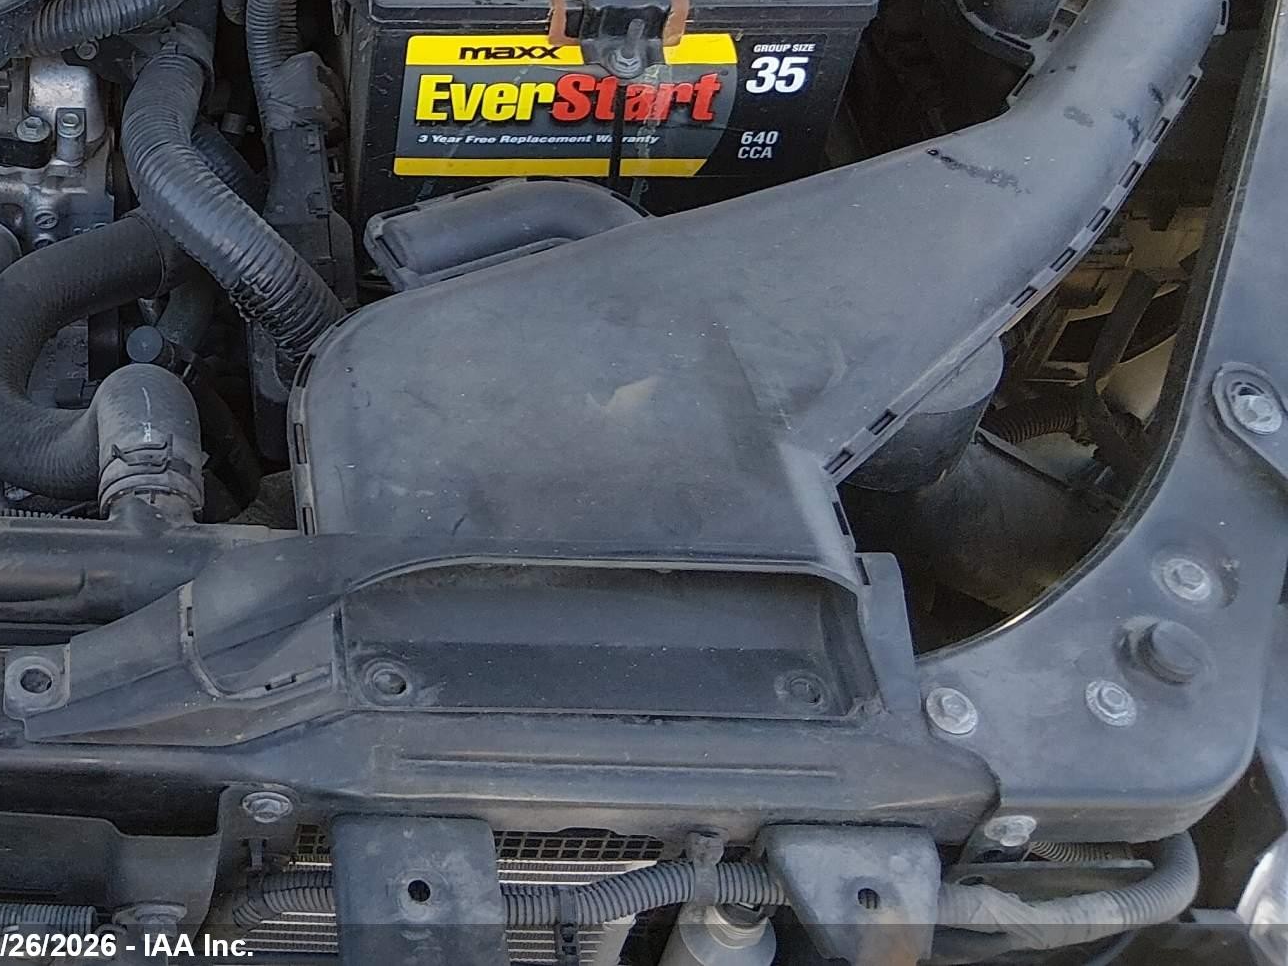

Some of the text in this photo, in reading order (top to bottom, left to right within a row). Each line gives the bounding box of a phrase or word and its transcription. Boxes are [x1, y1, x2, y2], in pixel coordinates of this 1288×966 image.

[459, 46, 560, 60] maxx
[753, 43, 816, 53] GROUP SIZE
[746, 56, 809, 94] 35
[415, 73, 721, 122] EverStart
[418, 135, 428, 143] 3
[432, 134, 462, 143] Year
[465, 135, 496, 144] Free
[500, 134, 592, 144] Replacement
[741, 131, 779, 145] 640
[737, 146, 773, 159] CCA
